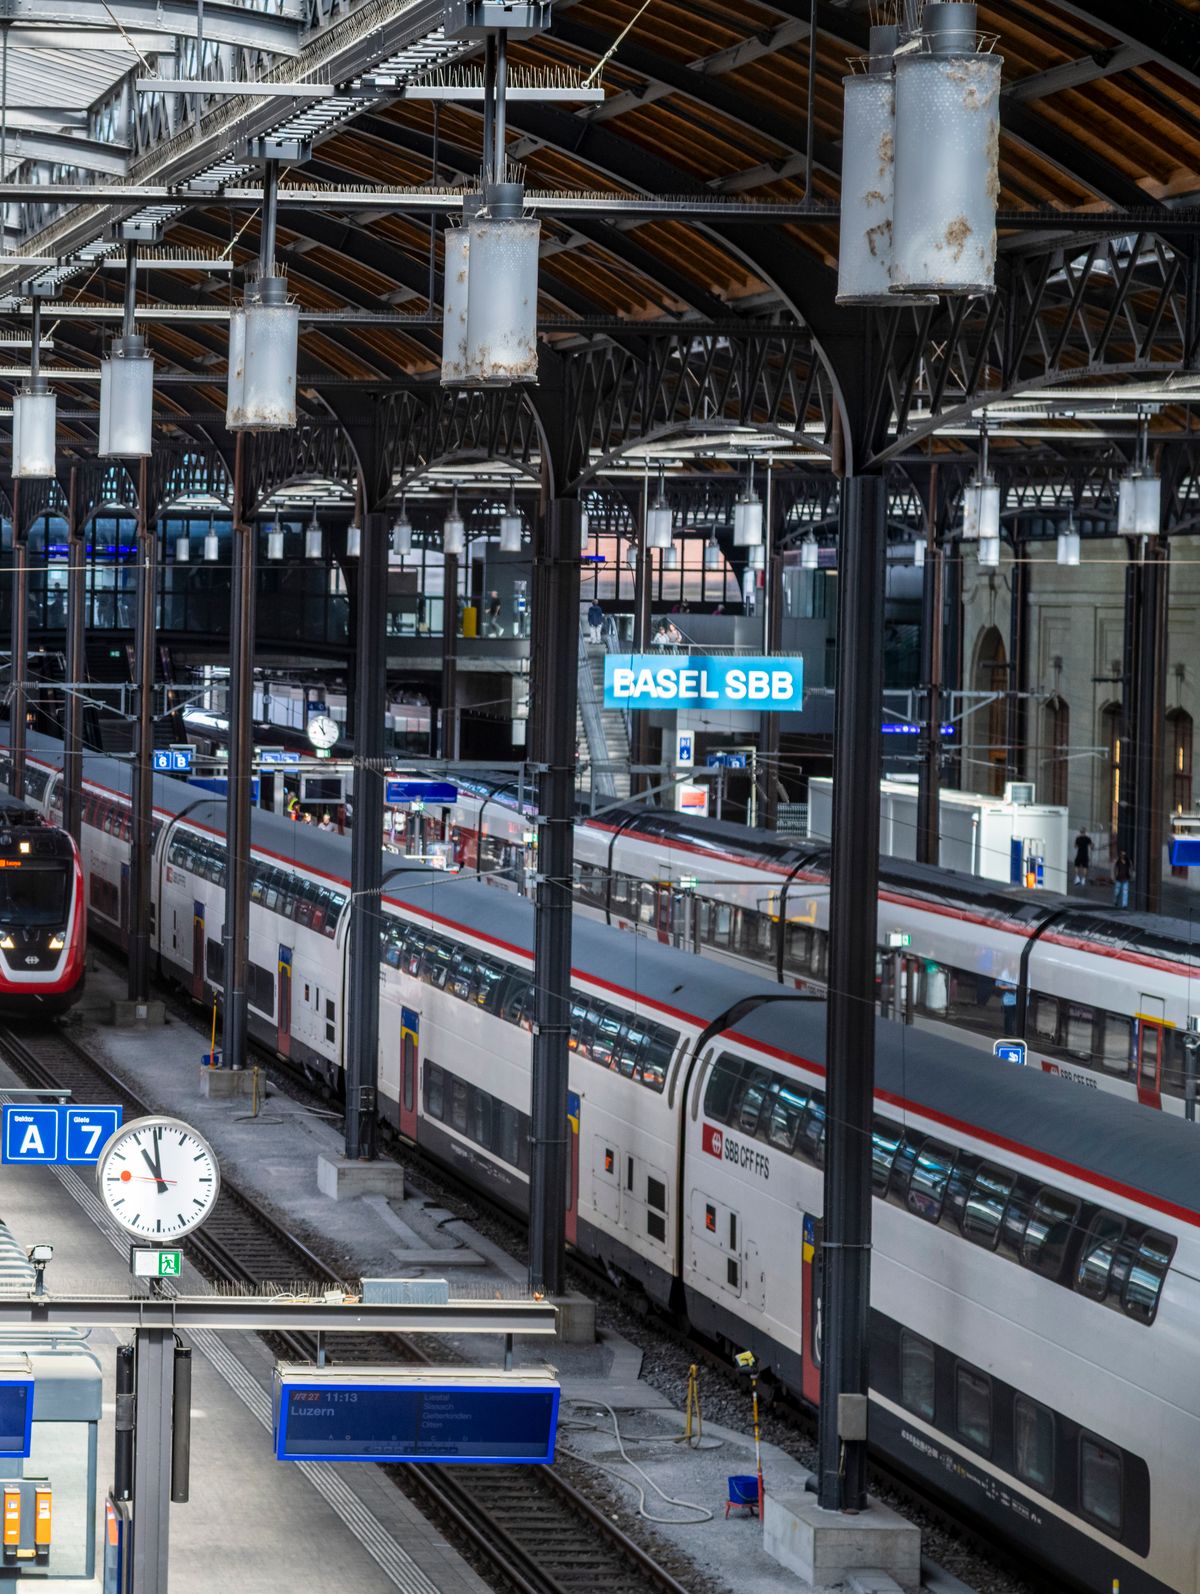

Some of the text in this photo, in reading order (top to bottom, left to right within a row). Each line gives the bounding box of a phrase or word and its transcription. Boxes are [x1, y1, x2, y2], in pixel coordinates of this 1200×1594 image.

[613, 668, 793, 700] BASEL SBB
[158, 756, 186, 767] 6 B
[20, 1124, 102, 1154] A 7
[725, 1138, 770, 1180] SBB CFF FFS
[326, 1392, 358, 1402] 11:13
[291, 1406, 335, 1416] Luzern
